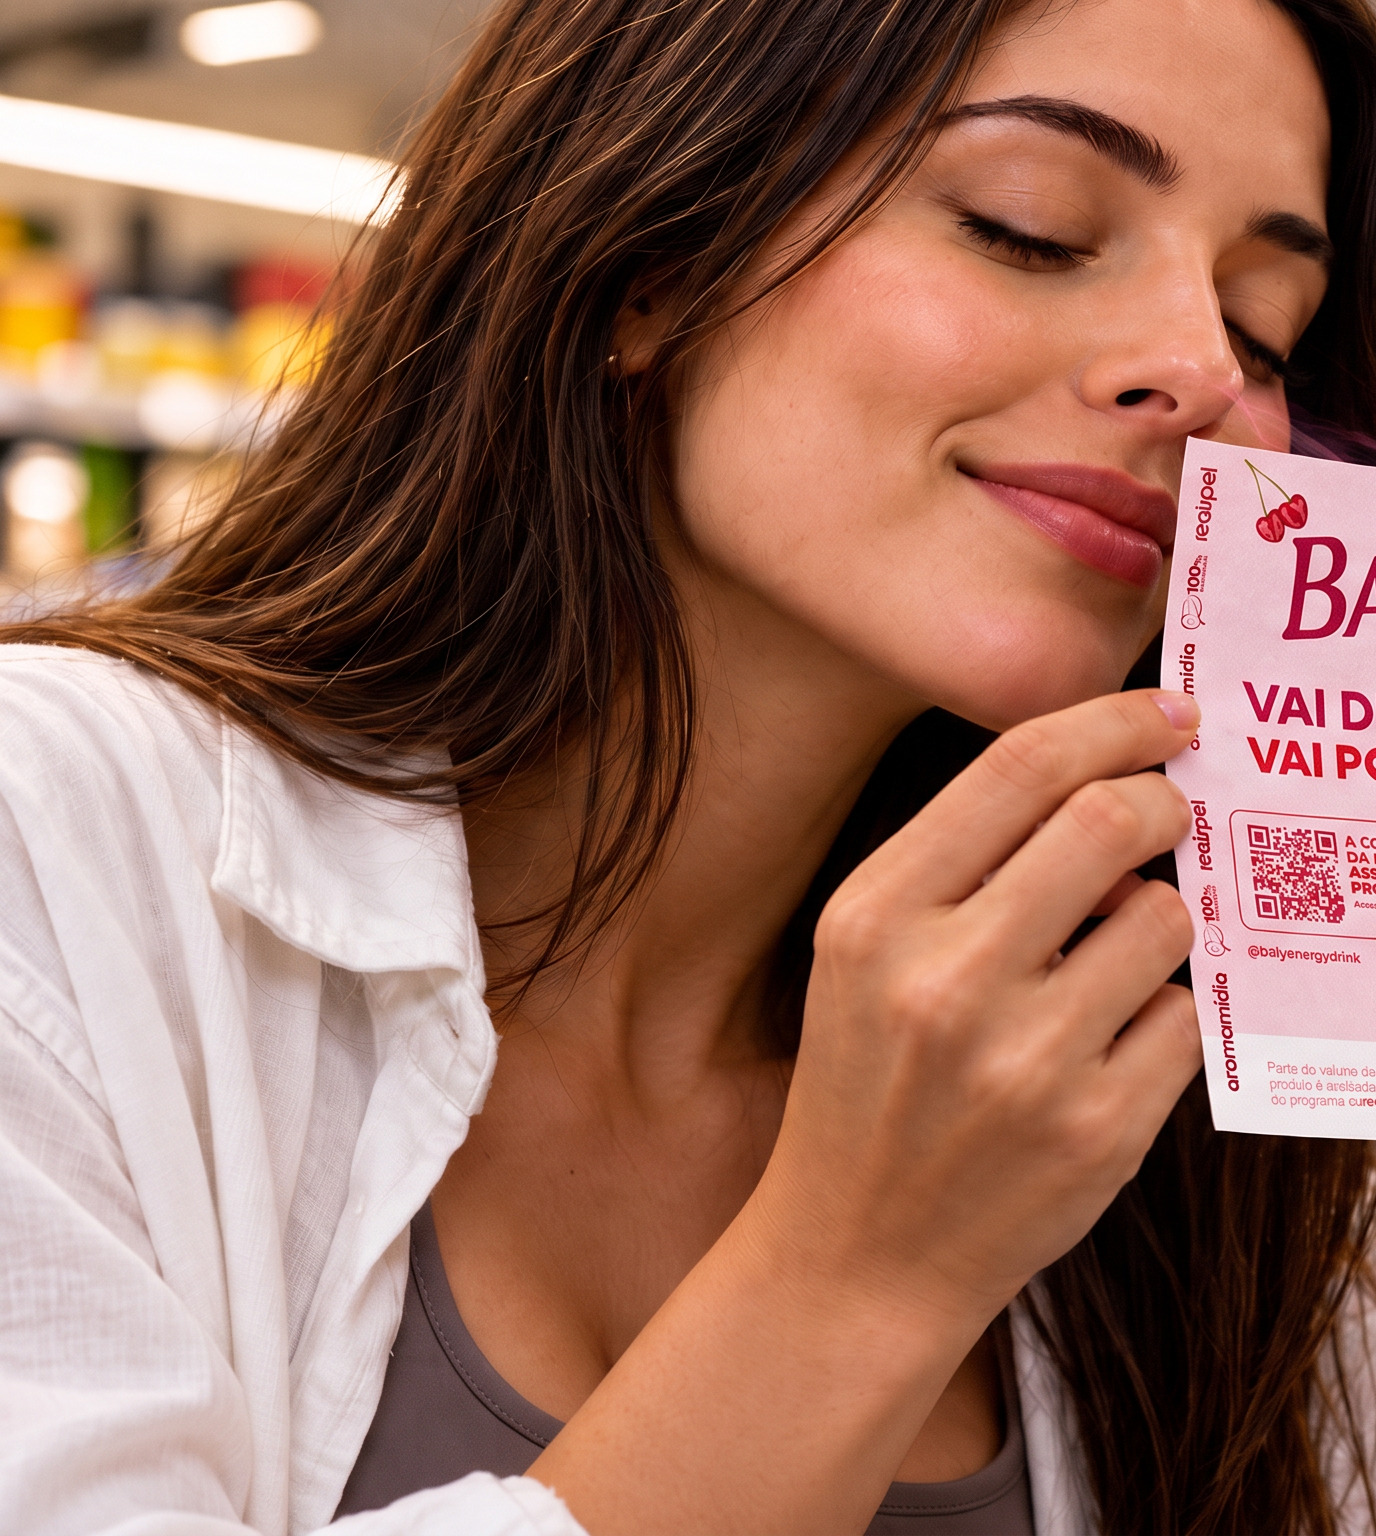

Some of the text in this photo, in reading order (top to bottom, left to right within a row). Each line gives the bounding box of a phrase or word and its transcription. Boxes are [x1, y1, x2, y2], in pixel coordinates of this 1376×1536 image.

[1178, 643, 1201, 751] amidia
[1242, 680, 1326, 728] VAI
[1246, 736, 1324, 778] VAI
[1345, 835, 1357, 848] A
[1346, 851, 1370, 865] DA
[1247, 945, 1362, 964] @balyenergydrink
[1267, 1061, 1299, 1074] Parte
[1301, 1063, 1317, 1075] do
[1290, 1096, 1345, 1109] programa
